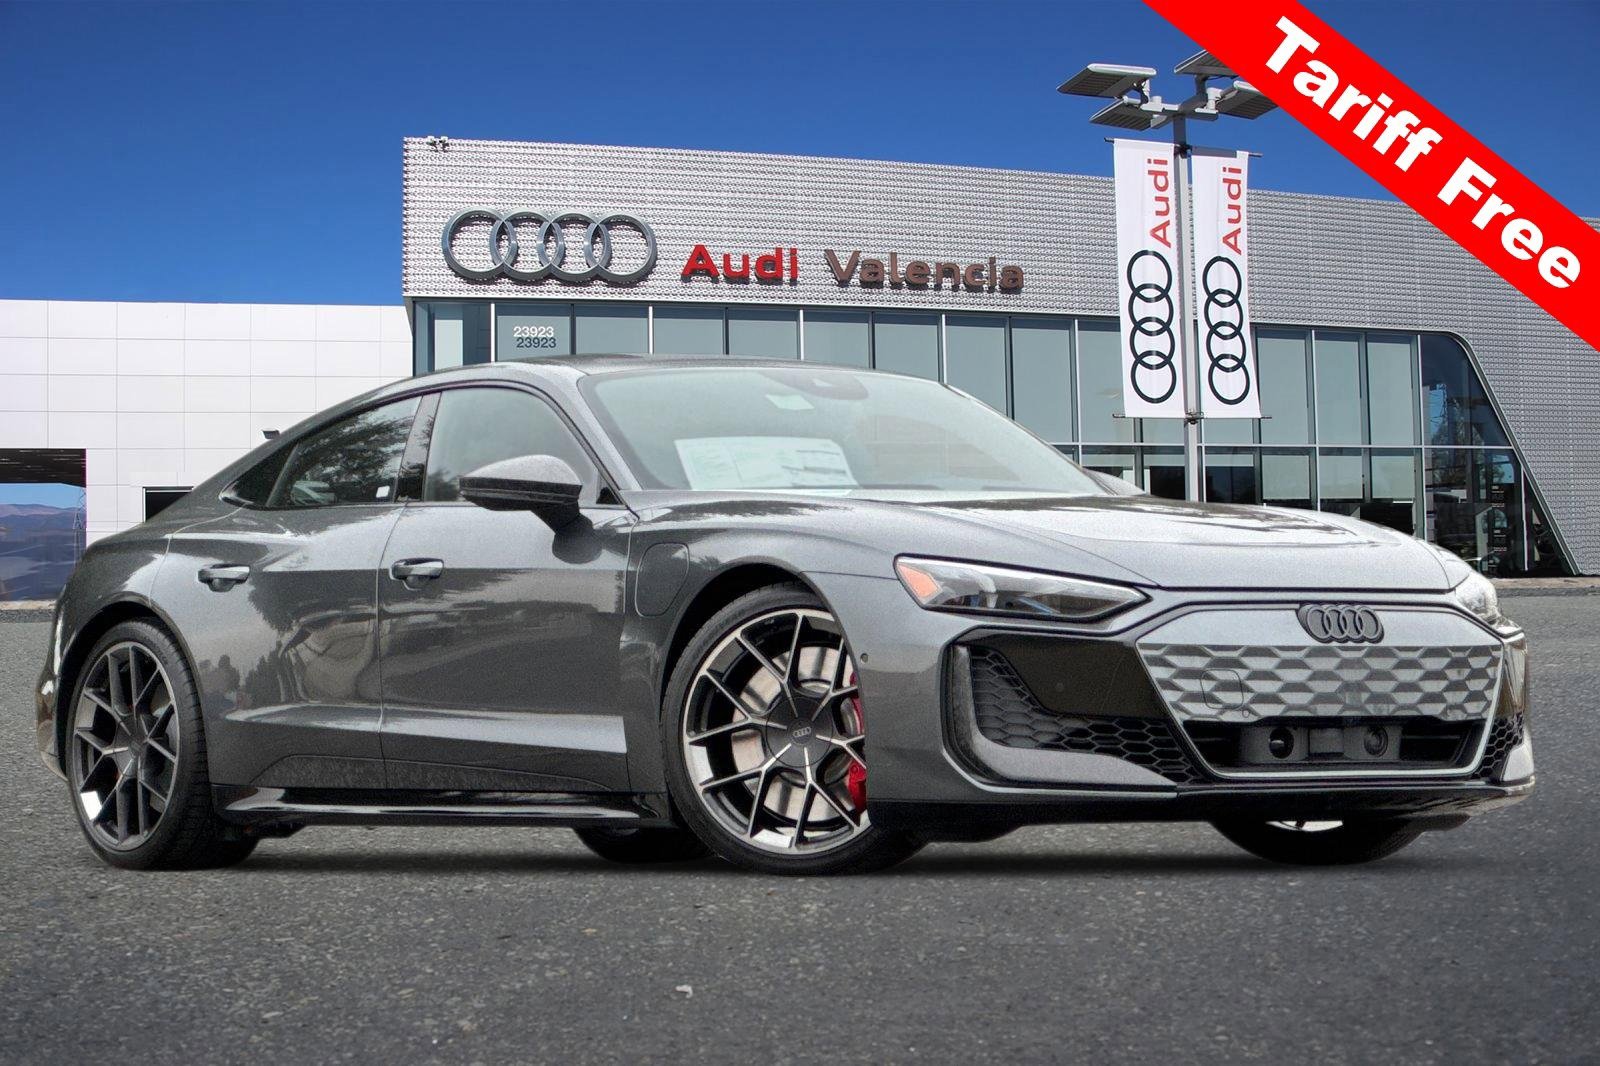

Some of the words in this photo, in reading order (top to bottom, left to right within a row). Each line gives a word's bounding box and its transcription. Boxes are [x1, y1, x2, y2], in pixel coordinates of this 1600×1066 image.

[1147, 157, 1172, 249] Audi
[1221, 166, 1243, 256] Audi
[681, 243, 799, 281] Audi
[823, 249, 1025, 291] Valencia
[513, 326, 554, 338] 23923
[516, 337, 557, 349] 23923
